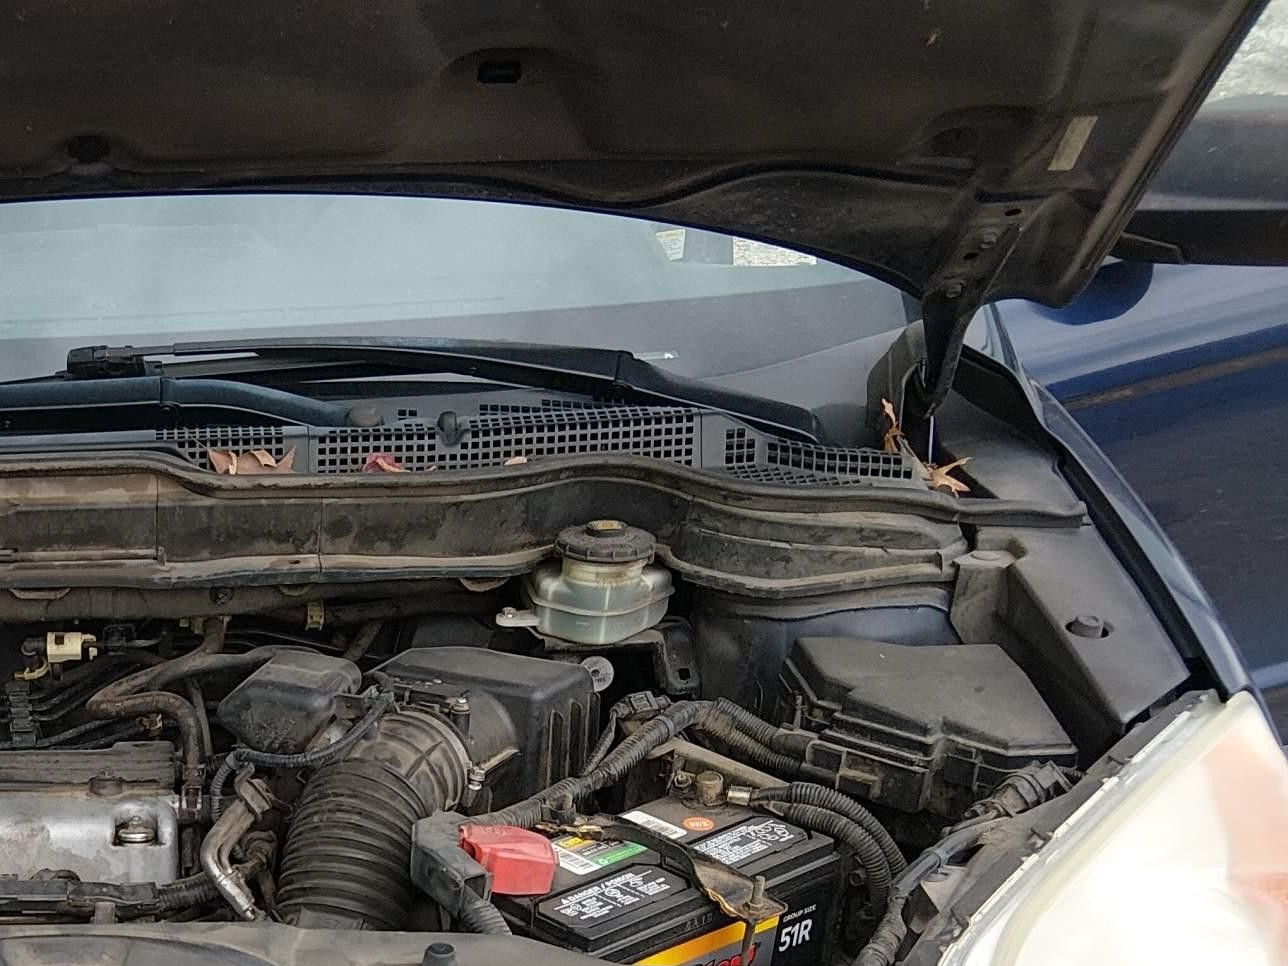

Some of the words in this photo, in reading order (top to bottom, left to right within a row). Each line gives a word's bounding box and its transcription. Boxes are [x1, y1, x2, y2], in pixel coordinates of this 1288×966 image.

[568, 886, 601, 901] DANGER
[782, 909, 804, 923] GROUP
[803, 903, 817, 915] SIZE
[778, 918, 813, 952] 51R
